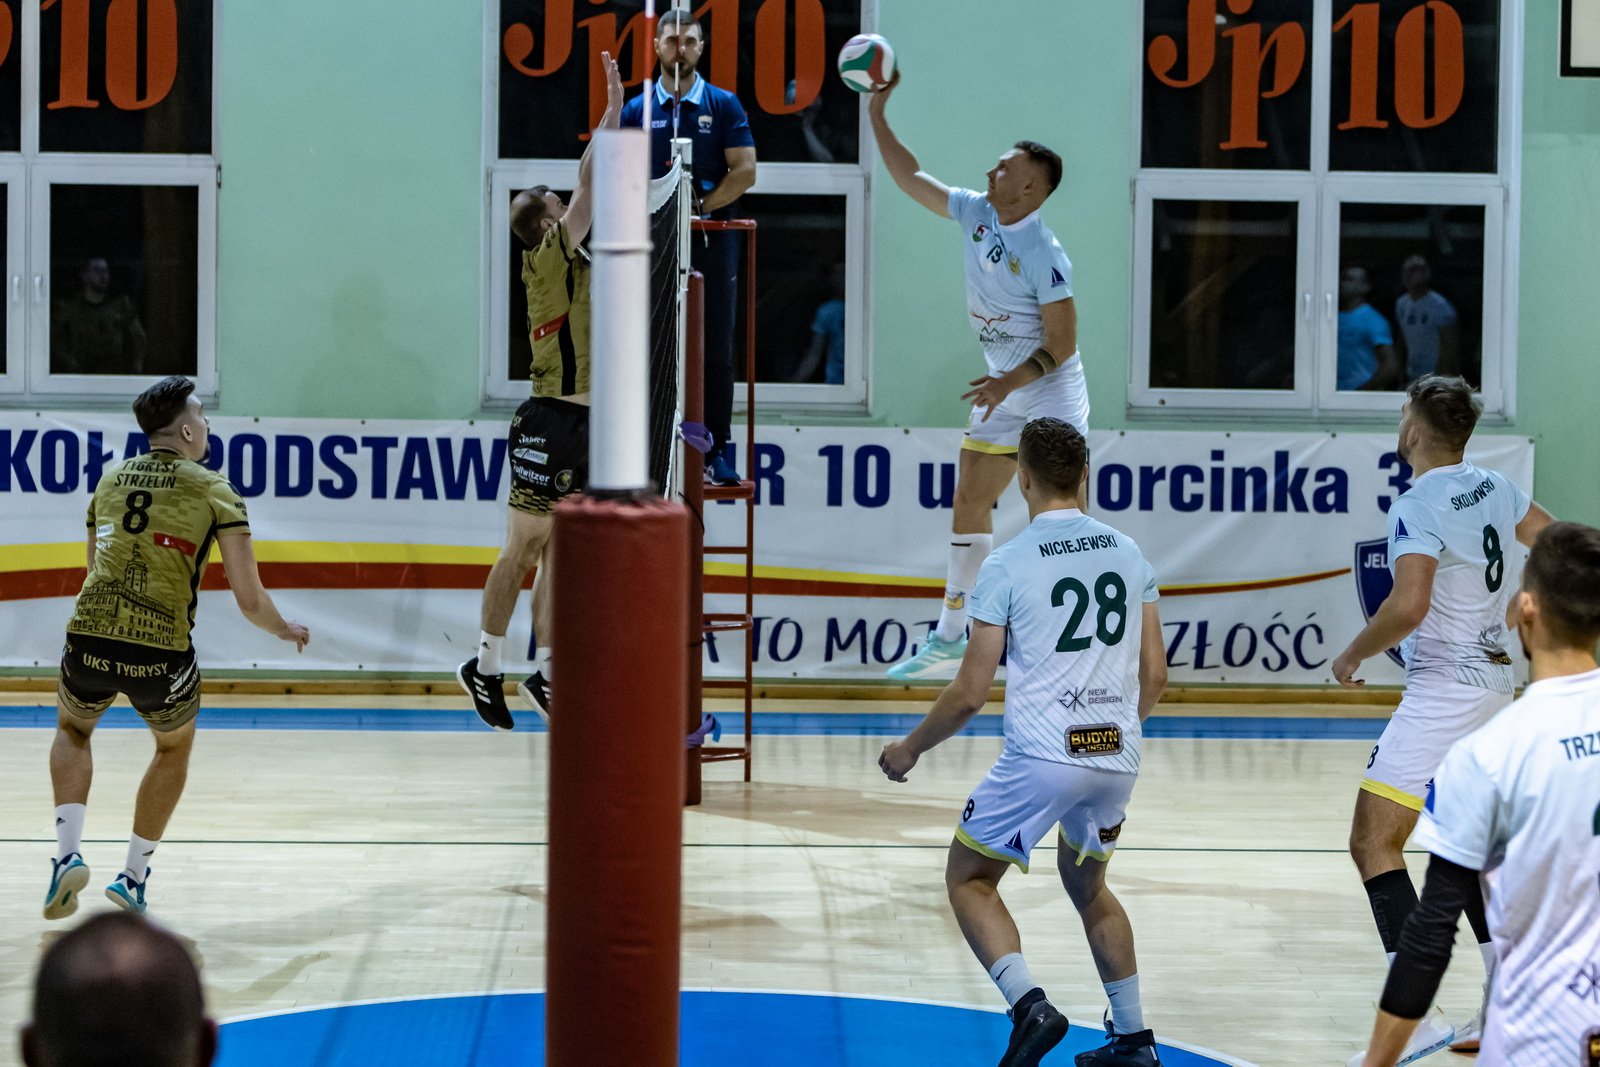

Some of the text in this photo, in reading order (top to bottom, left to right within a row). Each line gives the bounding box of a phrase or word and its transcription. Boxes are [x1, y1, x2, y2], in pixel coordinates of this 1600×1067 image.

[0, 429, 150, 493] KOŁ
[207, 433, 508, 500] ODSTAW
[818, 444, 892, 508] 10
[1087, 449, 1349, 514] orcinka
[122, 460, 182, 474] TYGRYSY
[114, 473, 177, 489] STRZELIN
[121, 490, 153, 534] 8
[1039, 534, 1118, 557] NICIEJEWSKI
[1483, 523, 1503, 592] 8
[1364, 552, 1388, 569] JEL
[1050, 571, 1127, 653] 28
[1163, 611, 1328, 672] ZŁOŚĆ
[83, 653, 168, 678] UKS TYGRYSY
[1088, 688, 1107, 696] NEW
[1088, 696, 1122, 704] DESIGN
[963, 798, 975, 822] 8
